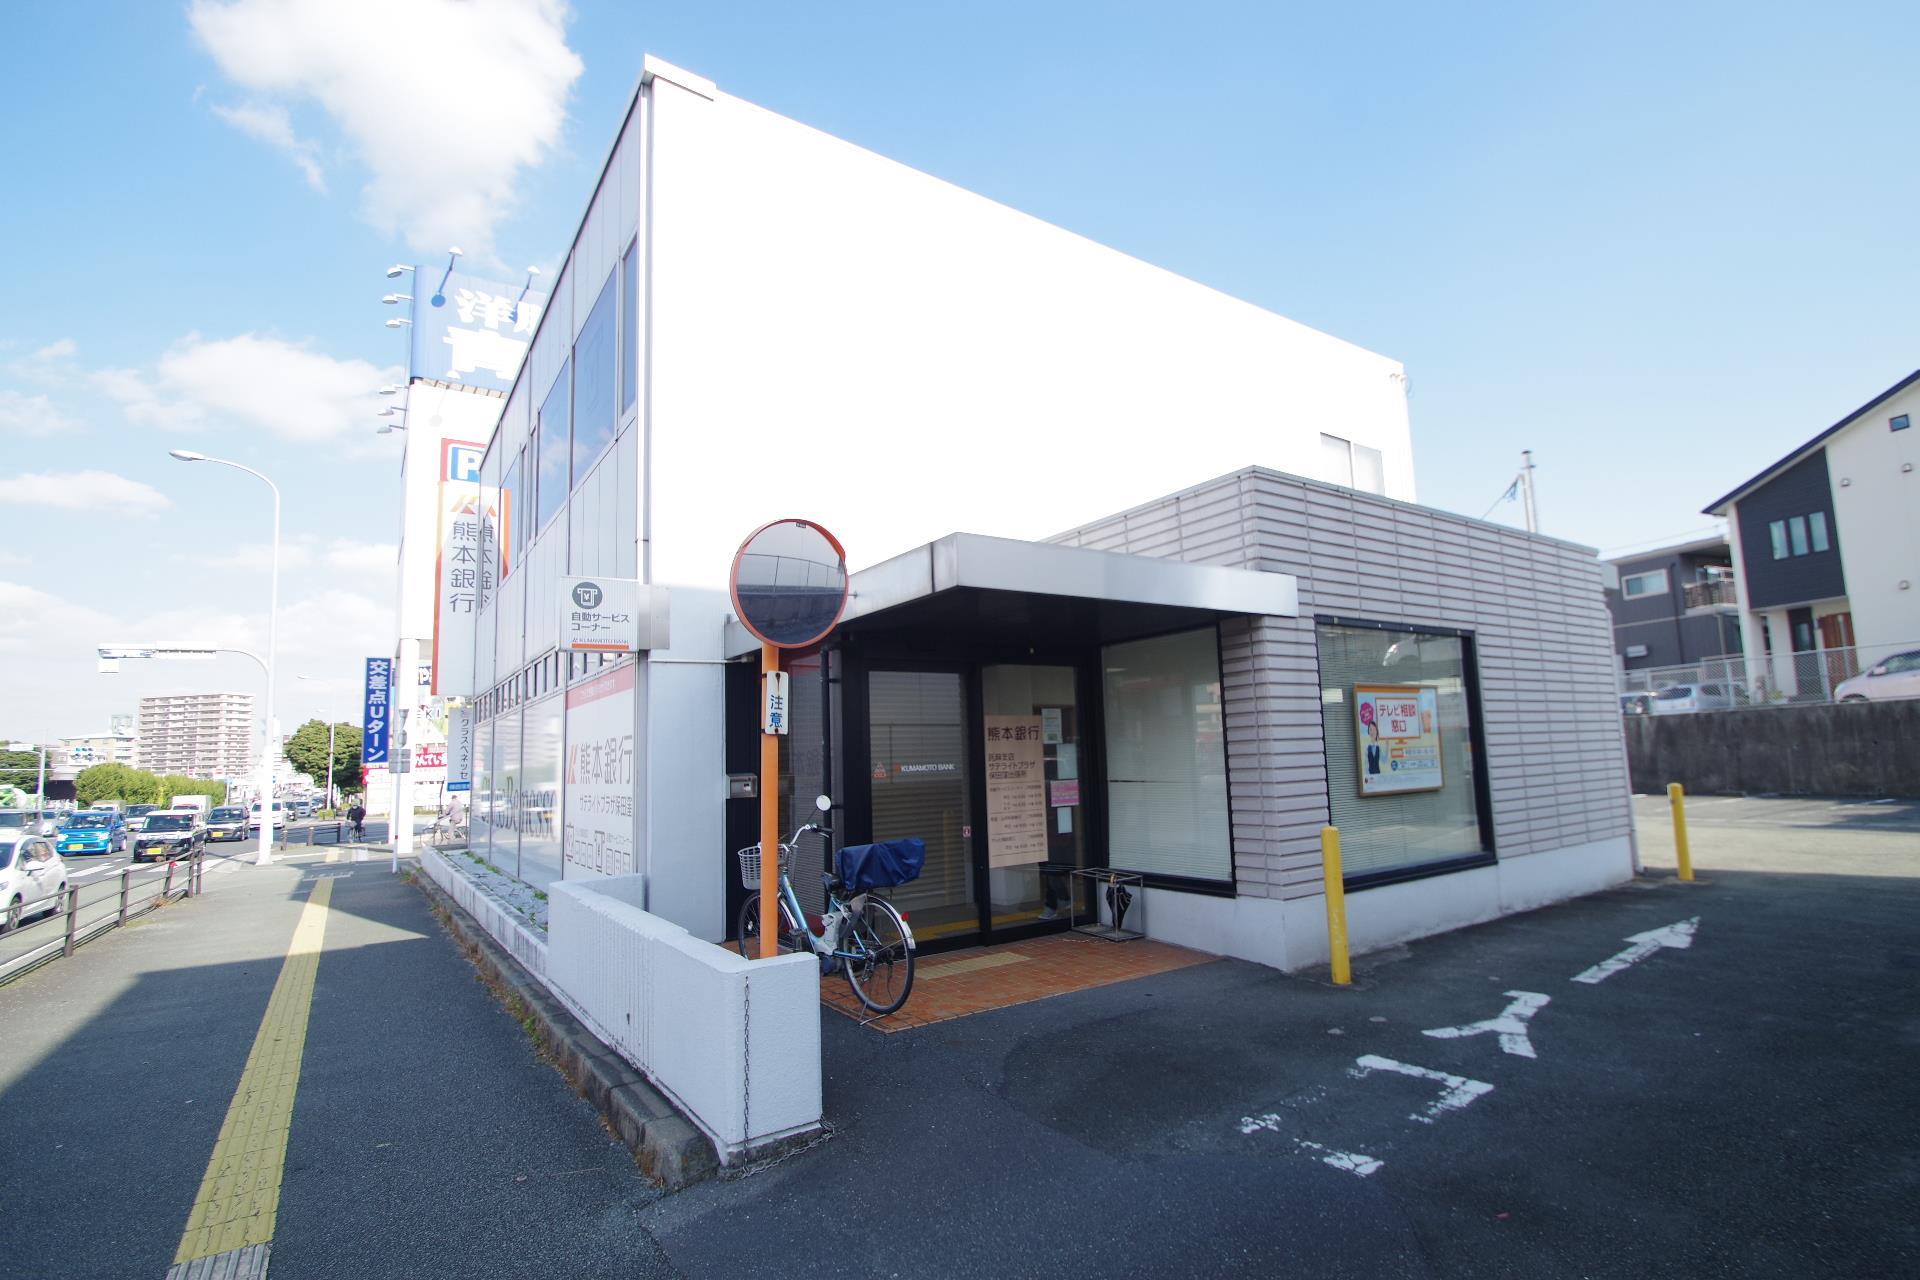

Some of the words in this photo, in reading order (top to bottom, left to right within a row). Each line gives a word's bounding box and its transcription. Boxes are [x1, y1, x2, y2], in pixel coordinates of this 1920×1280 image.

[449, 521, 478, 613] 熊本銀行
[571, 611, 630, 623] 自動サービス
[571, 622, 611, 632] コーナー
[367, 660, 389, 763] 交差点Uターン
[769, 694, 784, 728] 注意
[1378, 703, 1417, 717] テレビ相談
[987, 725, 1040, 742] 熊本銀行
[1390, 719, 1407, 733] 窓口
[460, 718, 470, 780] クラスベネッセ
[579, 734, 633, 785] 熊本銀行
[901, 764, 936, 773] KUMAMOTO
[938, 763, 955, 771] BANK
